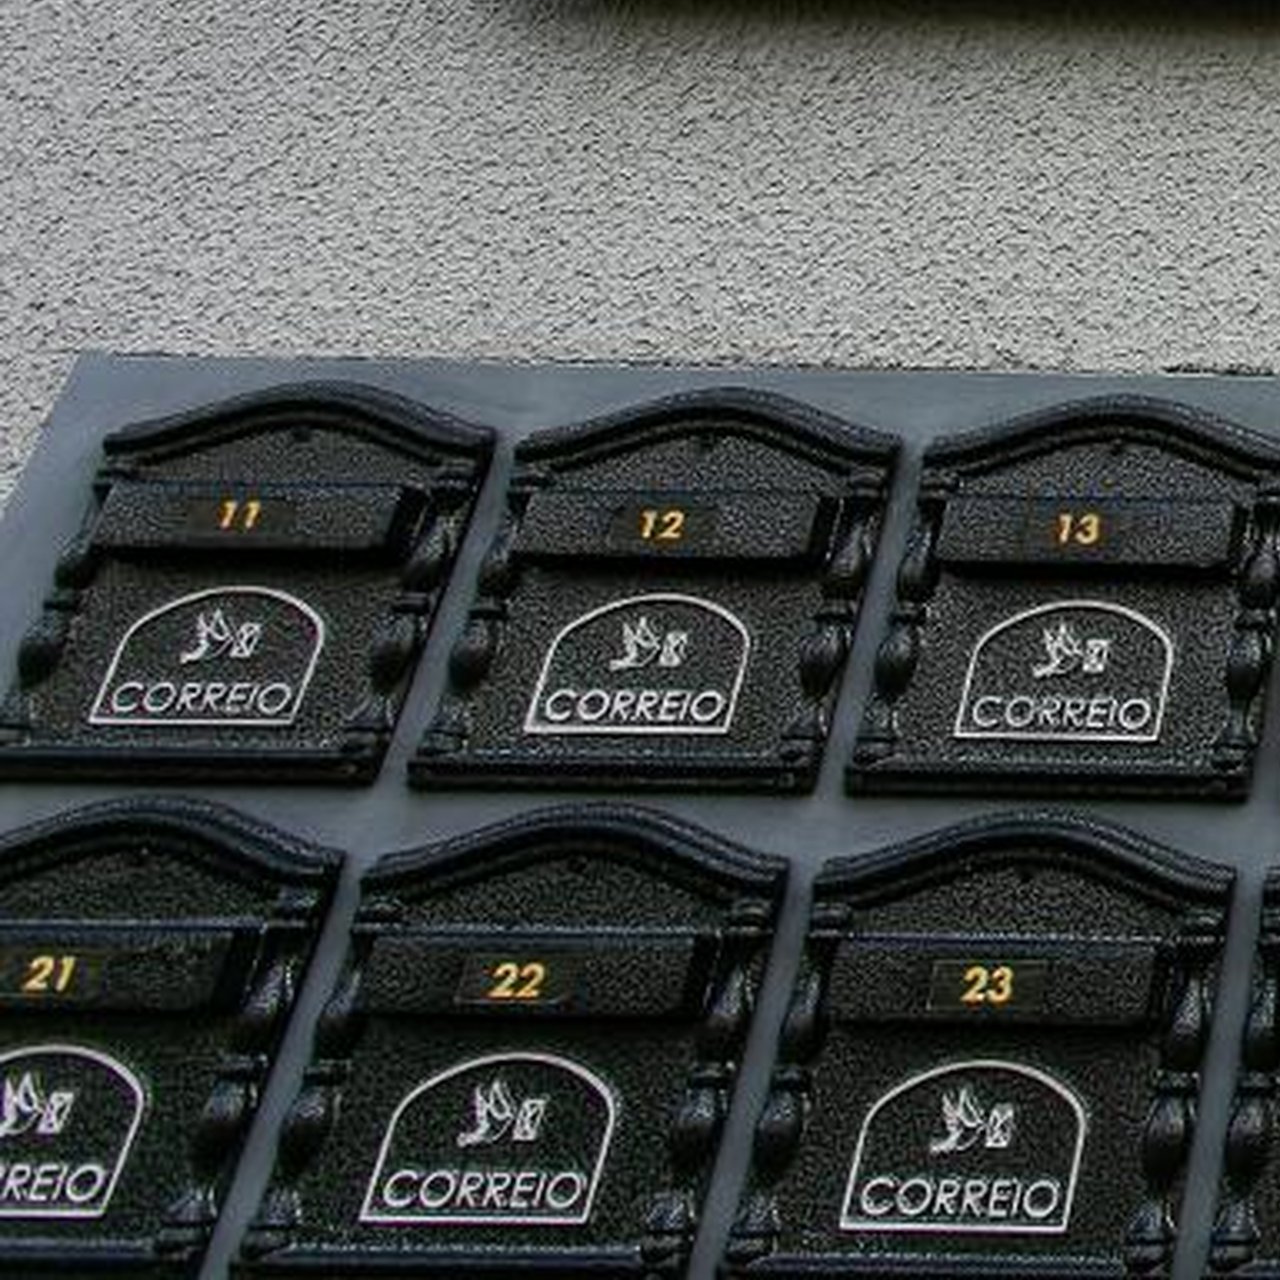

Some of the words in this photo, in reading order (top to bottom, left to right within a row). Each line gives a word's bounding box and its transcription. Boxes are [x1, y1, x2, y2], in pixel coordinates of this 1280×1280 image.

[216, 499, 262, 530] 11
[638, 509, 686, 540] 12
[1056, 514, 1102, 544] 13
[111, 681, 292, 715] CORREIO
[544, 689, 726, 722] CORREIO
[970, 695, 1152, 731] CORREIO
[21, 956, 76, 992] 21
[490, 963, 547, 998] 22
[961, 966, 1013, 1003] 23
[0, 1163, 104, 1203] REIO
[382, 1168, 588, 1209] CORREIO
[860, 1177, 1061, 1218] CORREIO
